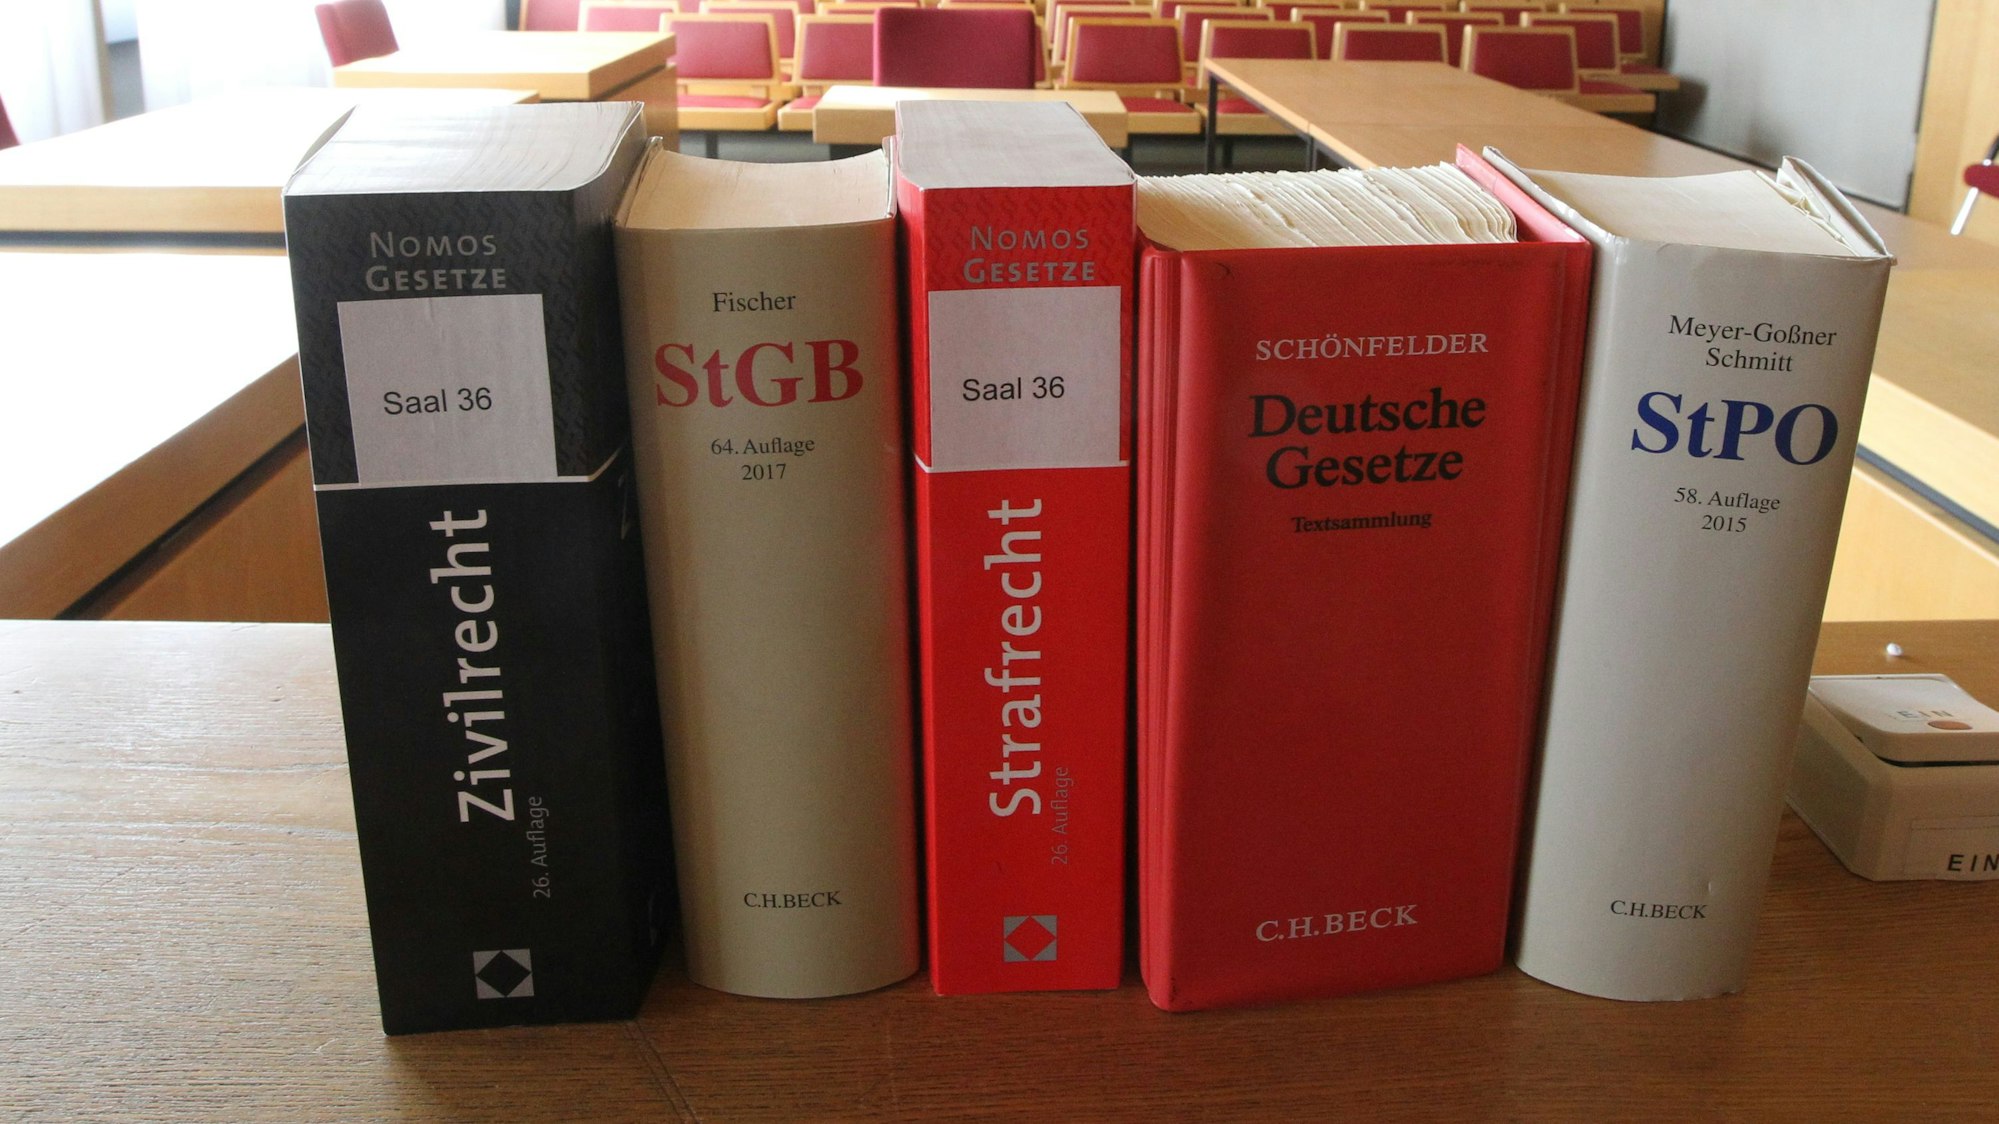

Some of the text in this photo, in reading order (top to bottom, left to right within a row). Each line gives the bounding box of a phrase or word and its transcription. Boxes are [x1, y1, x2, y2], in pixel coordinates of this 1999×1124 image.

[712, 291, 796, 312] Fischer
[1668, 315, 1837, 346] Meyer-Goßner
[1255, 333, 1488, 361] SCHÖNFELDER
[1706, 347, 1793, 372] Schmitt
[655, 339, 864, 408] StGB
[383, 387, 493, 415] Saal 36
[962, 376, 1065, 401] Saal 36
[1248, 387, 1486, 438] Deutsche
[1631, 391, 1838, 466] StPO
[711, 437, 815, 456] 64. Auflage
[741, 463, 786, 480] 2017
[1266, 445, 1464, 490] Gesetze
[1674, 487, 1780, 514] 58. Auflage
[1291, 511, 1433, 533] Textsammlung
[1701, 514, 1746, 533] 2015
[429, 509, 515, 823] Zivilrecht
[984, 498, 1042, 818] Strafrecht
[1051, 766, 1074, 865] 26. Auflage
[528, 795, 551, 899] 26. Auflage
[743, 890, 842, 909] C.H.BECK
[1610, 899, 1708, 920] C.H.BECK
[1255, 904, 1418, 942] C.H.BECK
